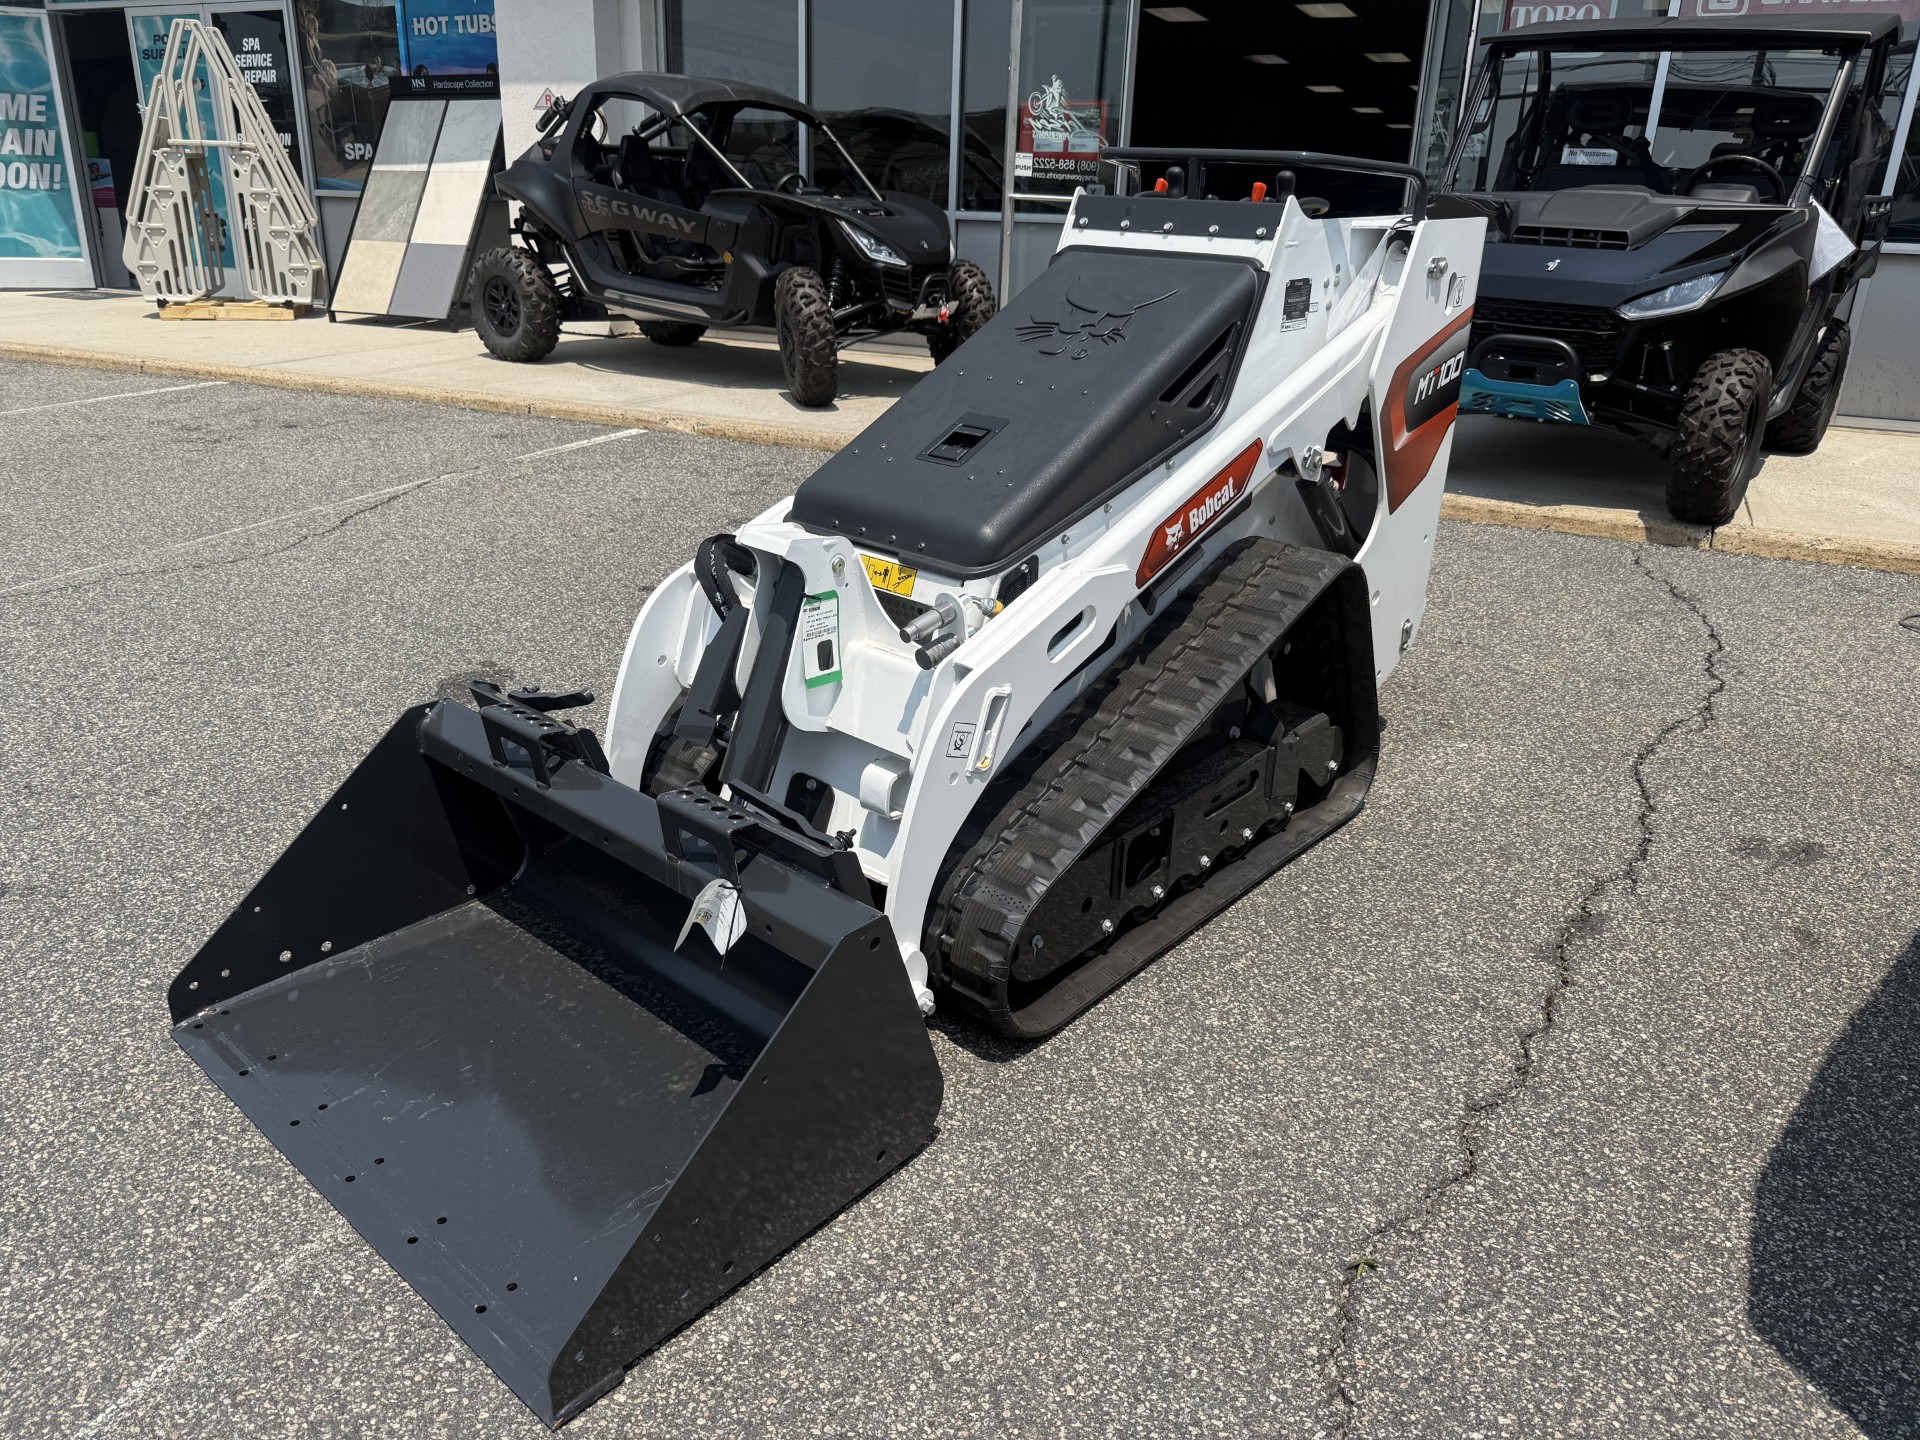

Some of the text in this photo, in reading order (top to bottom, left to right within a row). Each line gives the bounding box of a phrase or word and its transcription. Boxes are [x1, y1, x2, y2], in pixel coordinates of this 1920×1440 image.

[1510, 4, 1601, 28] TORO
[412, 15, 449, 36] HOT
[242, 38, 261, 52] SPA
[235, 54, 272, 68] SERVICE
[244, 69, 277, 83] REPAIR
[411, 78, 426, 90] MSI
[433, 79, 494, 90] Hardscape Collection
[544, 94, 552, 105] R
[344, 143, 373, 161] SPA
[1568, 149, 1578, 157] No
[0, 162, 61, 190] ON!
[580, 190, 697, 234] SEGWAY
[1413, 349, 1465, 406] MT100
[1189, 476, 1235, 534] Bobcat
